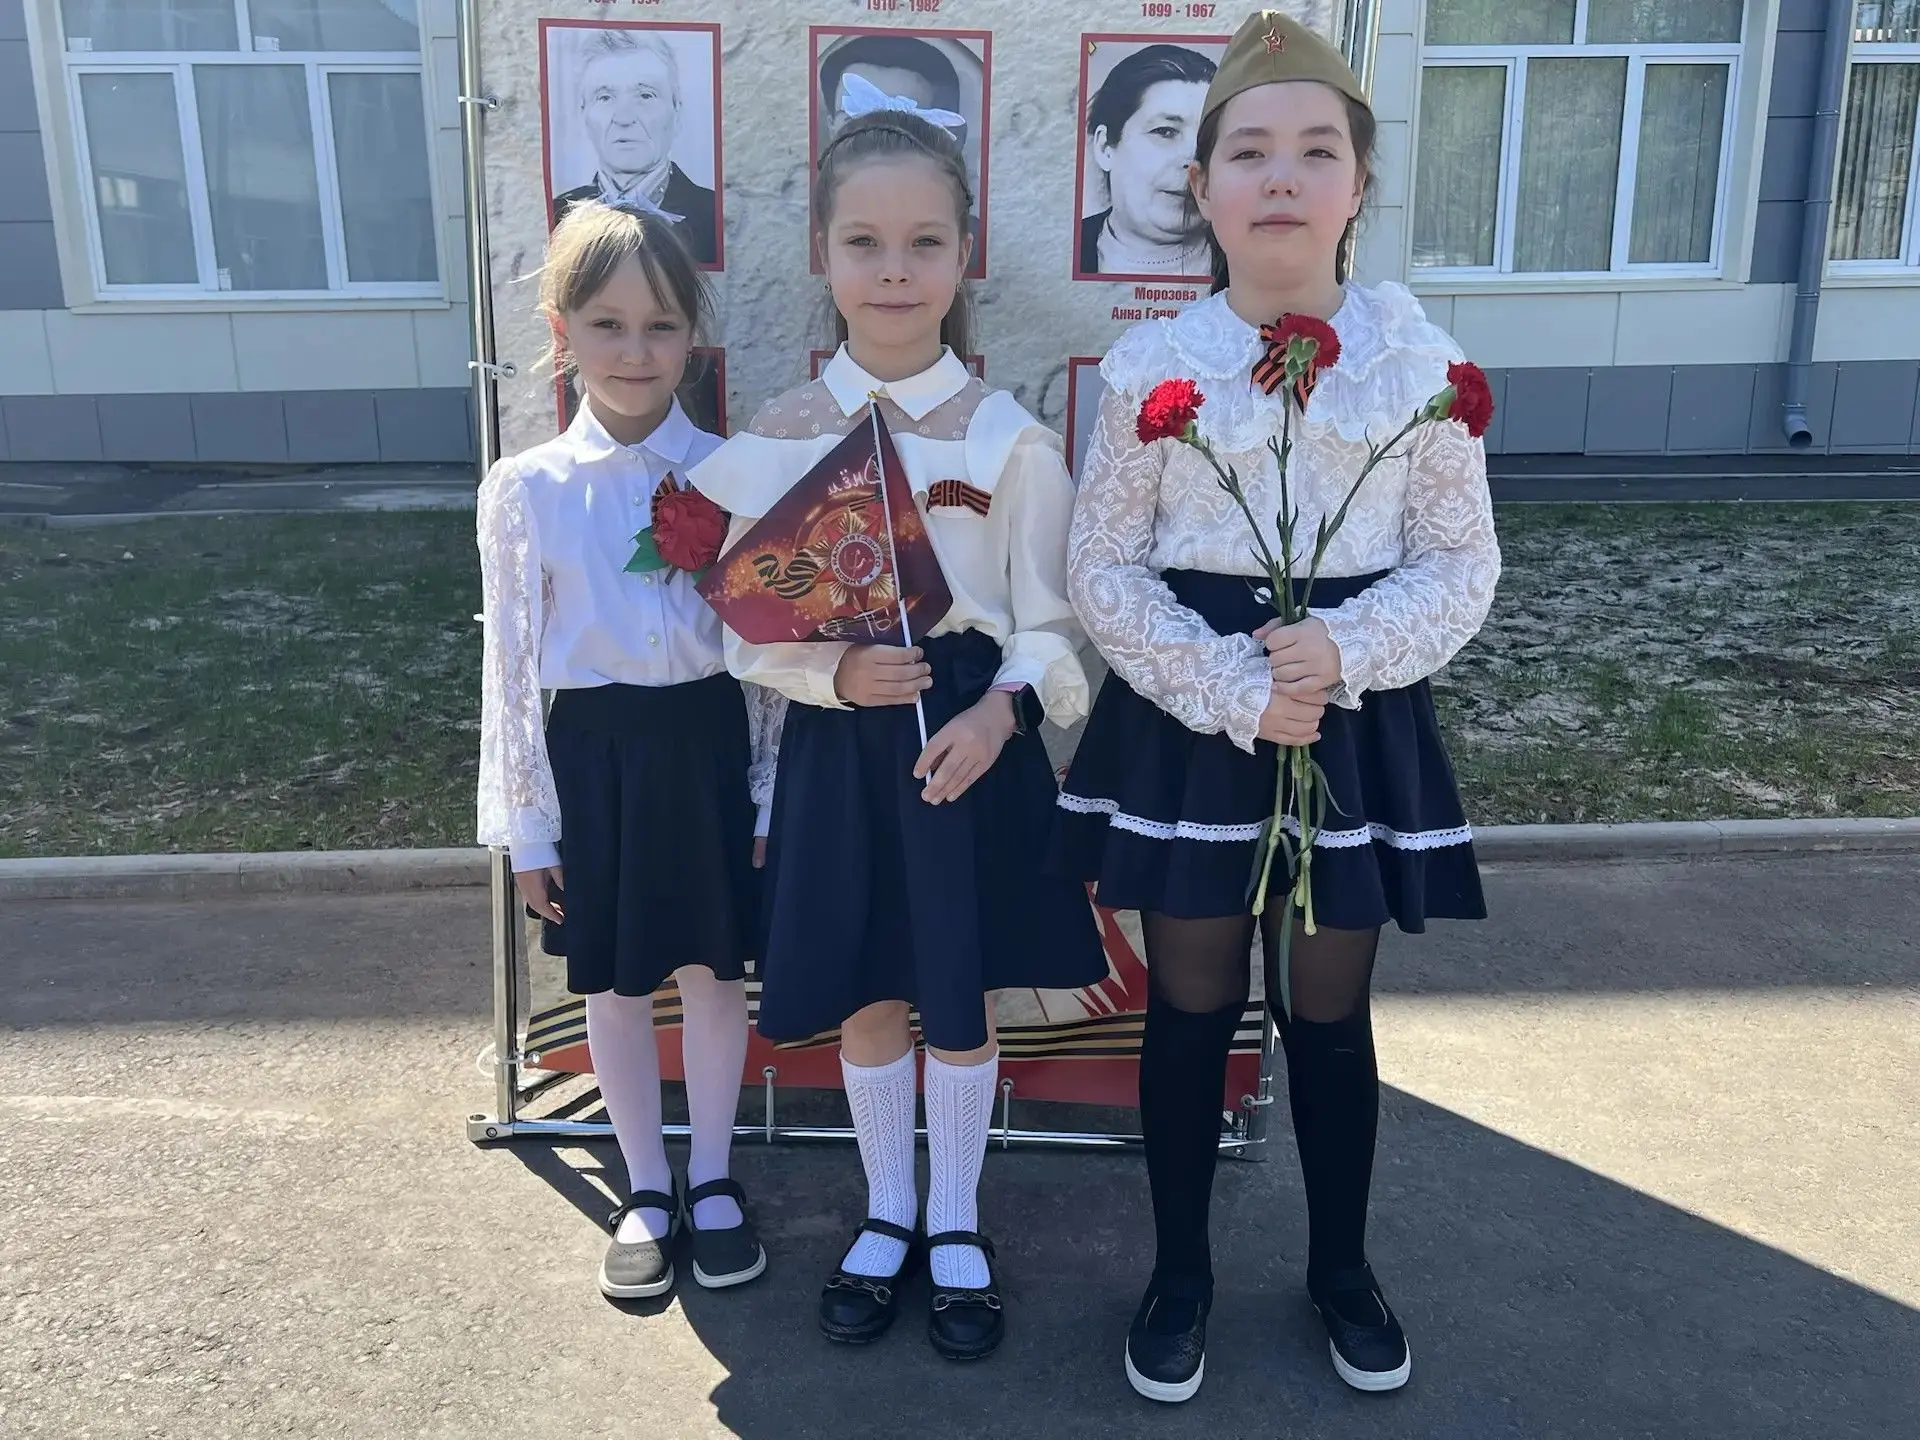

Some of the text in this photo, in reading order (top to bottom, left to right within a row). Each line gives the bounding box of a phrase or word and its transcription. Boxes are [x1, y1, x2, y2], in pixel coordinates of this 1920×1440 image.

[867, 0, 896, 10] 1910
[909, 0, 939, 12] 1982
[1142, 3, 1172, 17] 1899
[1185, 4, 1216, 18] 1967
[1134, 286, 1197, 302] Морозова
[1111, 306, 1142, 320] Анна
